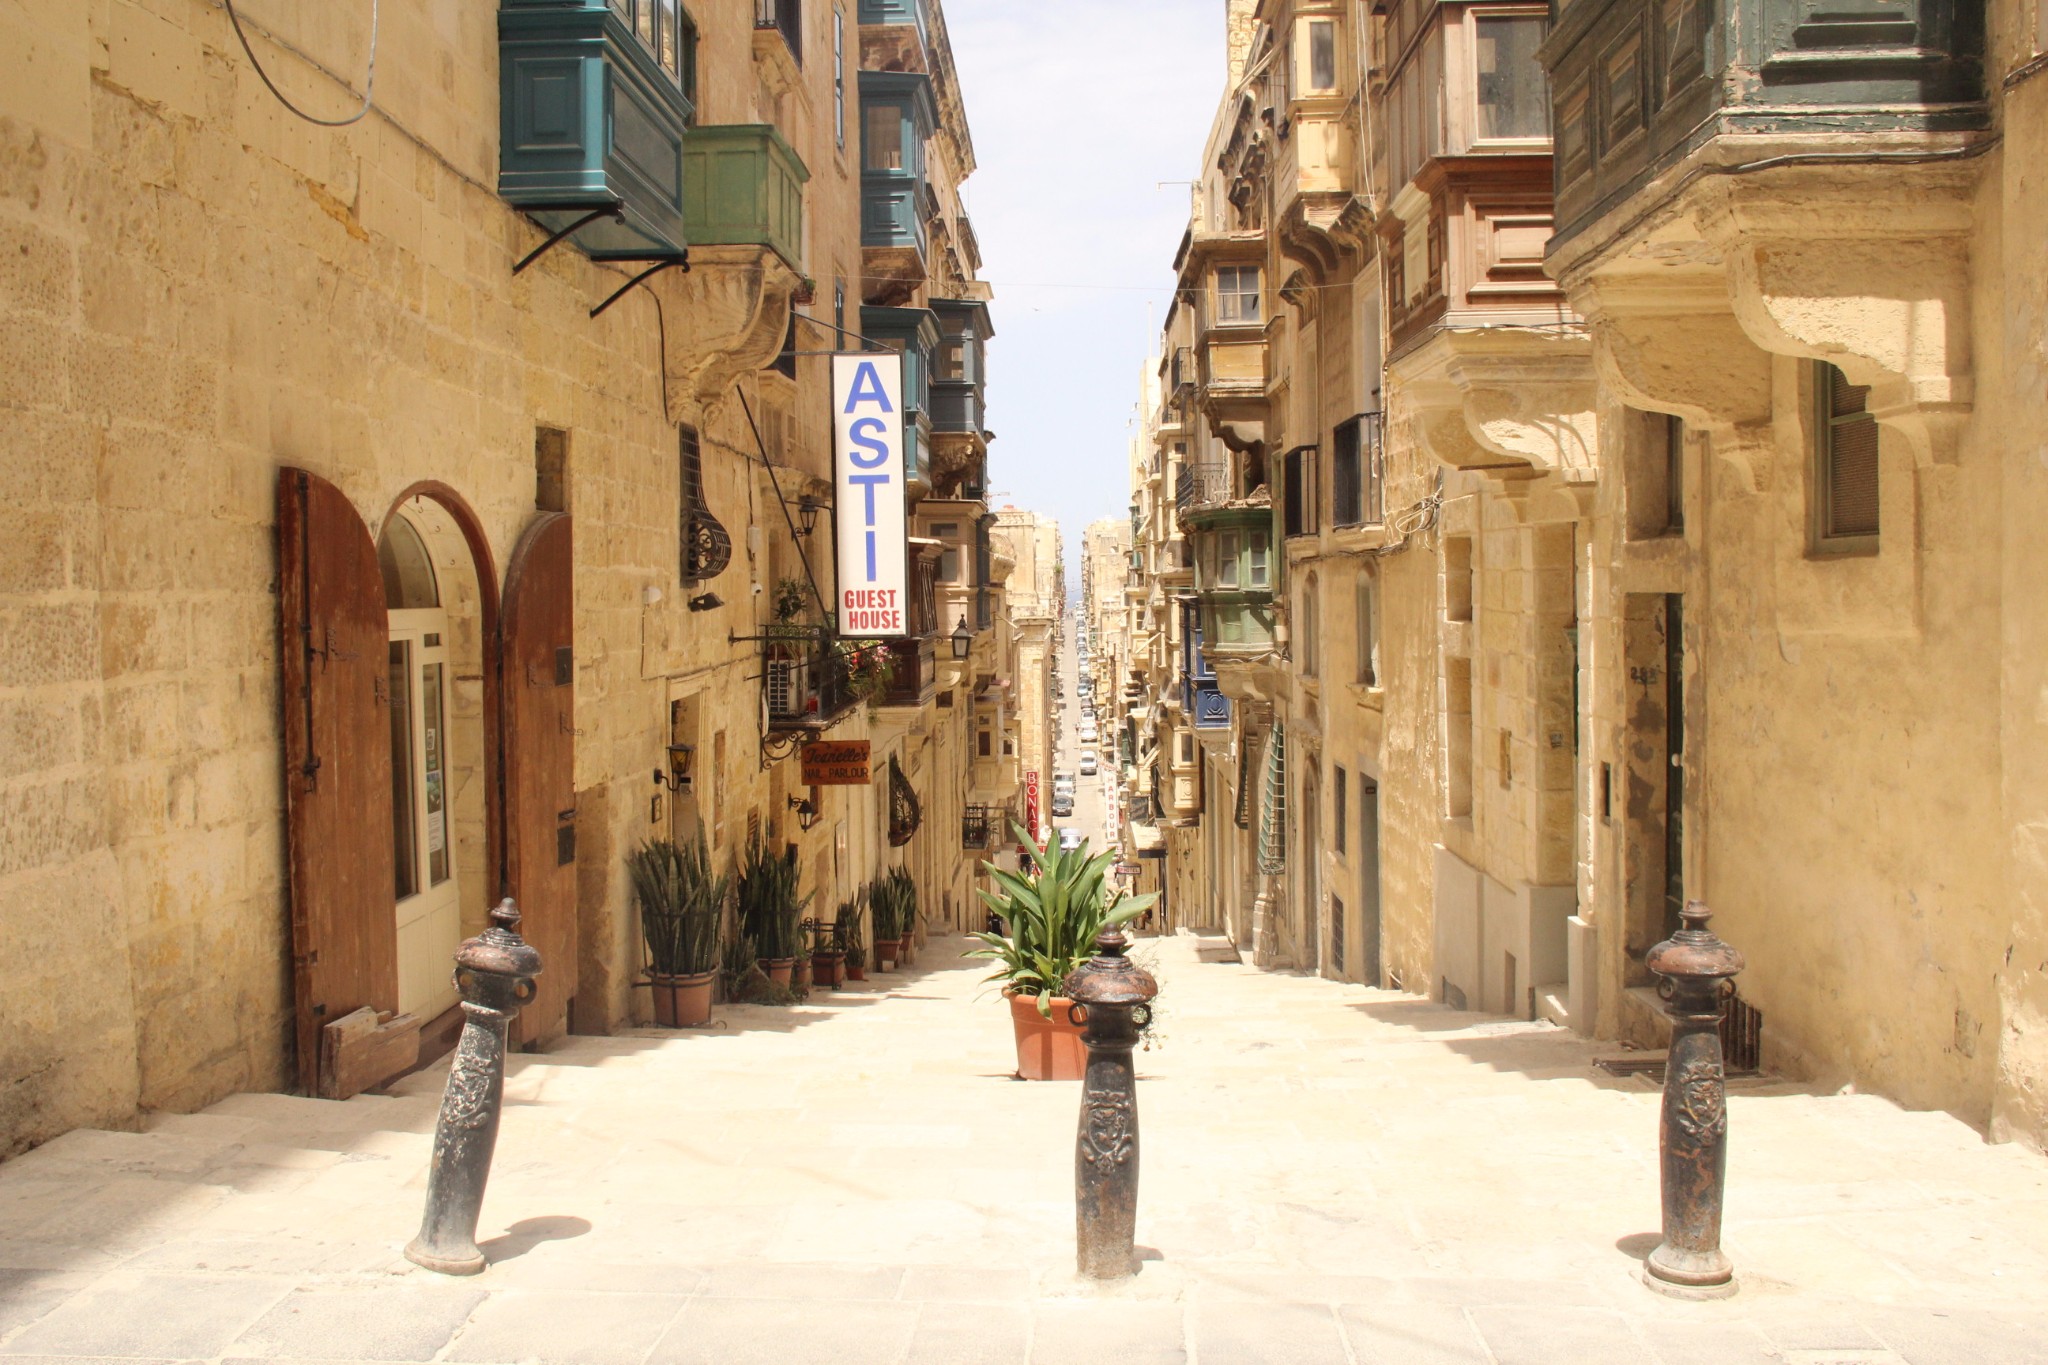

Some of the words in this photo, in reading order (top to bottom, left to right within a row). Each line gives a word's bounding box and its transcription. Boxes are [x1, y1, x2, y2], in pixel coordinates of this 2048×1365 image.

[843, 361, 894, 582] ASTI
[844, 590, 896, 609] GUEST
[849, 610, 900, 629] HOUSE
[804, 768, 823, 779] NAIL
[829, 767, 869, 779] PARLOUR
[1107, 777, 1115, 838] HARBOUR
